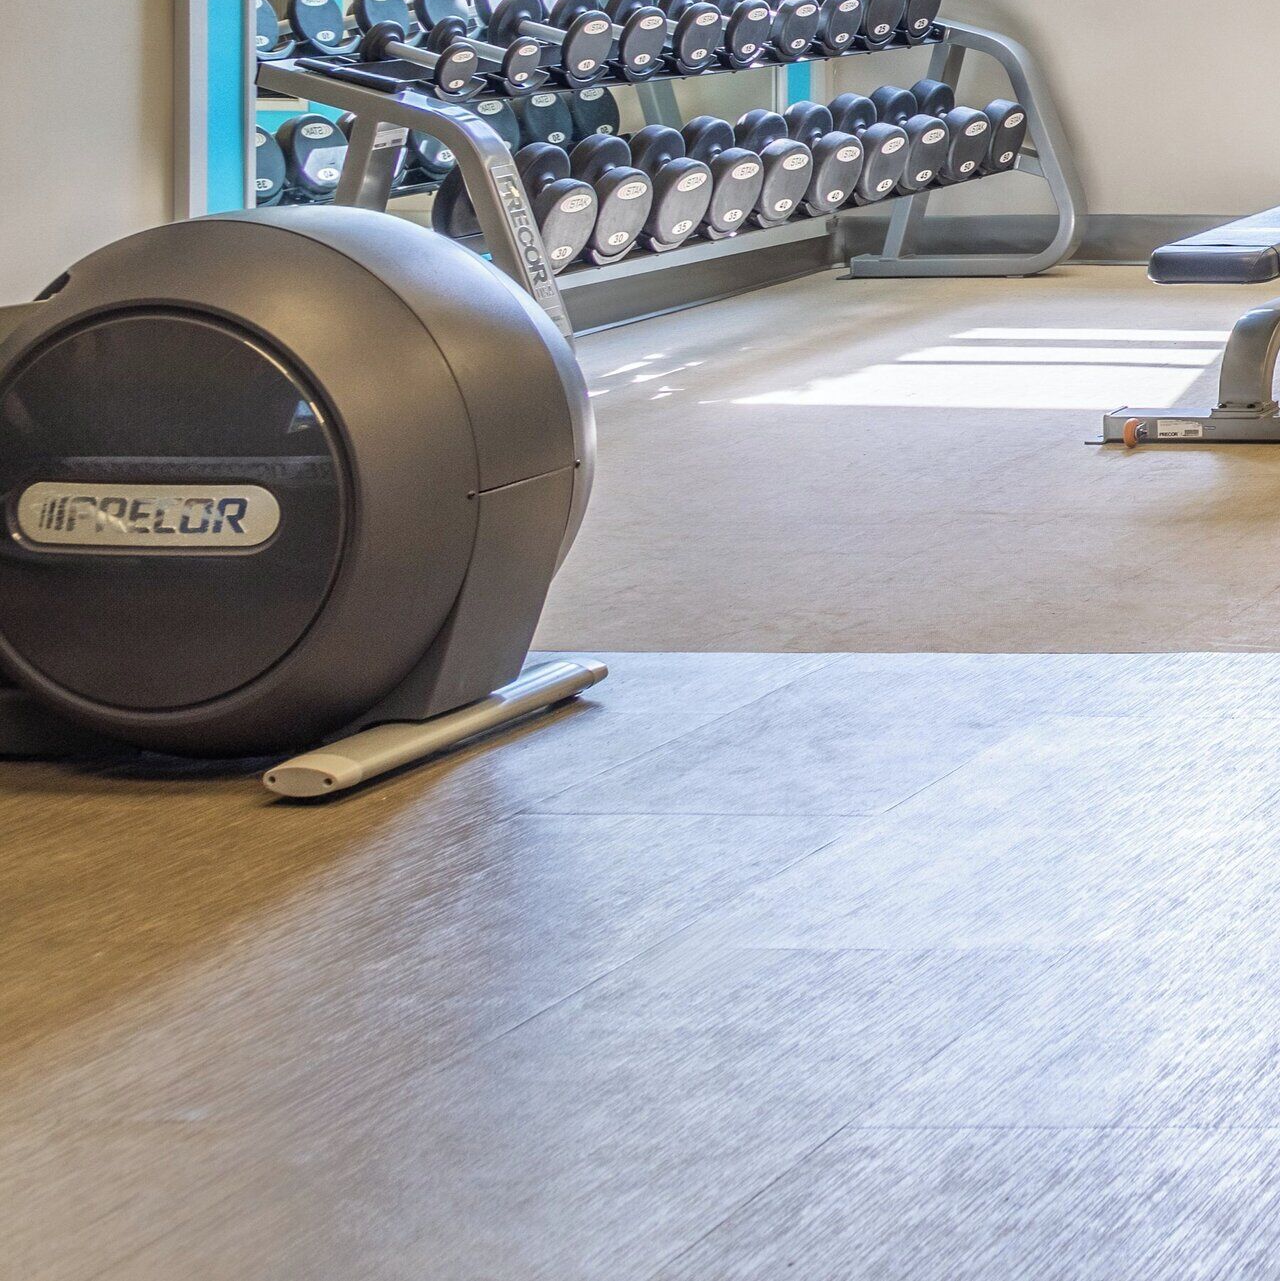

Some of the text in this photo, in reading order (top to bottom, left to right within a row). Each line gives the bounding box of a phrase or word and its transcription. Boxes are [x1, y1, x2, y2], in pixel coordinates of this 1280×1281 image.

[918, 20, 925, 28] 25
[878, 25, 886, 33] 25
[696, 50, 703, 58] 15
[583, 61, 591, 69] 10
[920, 171, 929, 179] 45
[678, 222, 687, 231] 35
[613, 234, 624, 243] 30
[556, 248, 567, 258] 30
[67, 496, 249, 534] PRECOR
